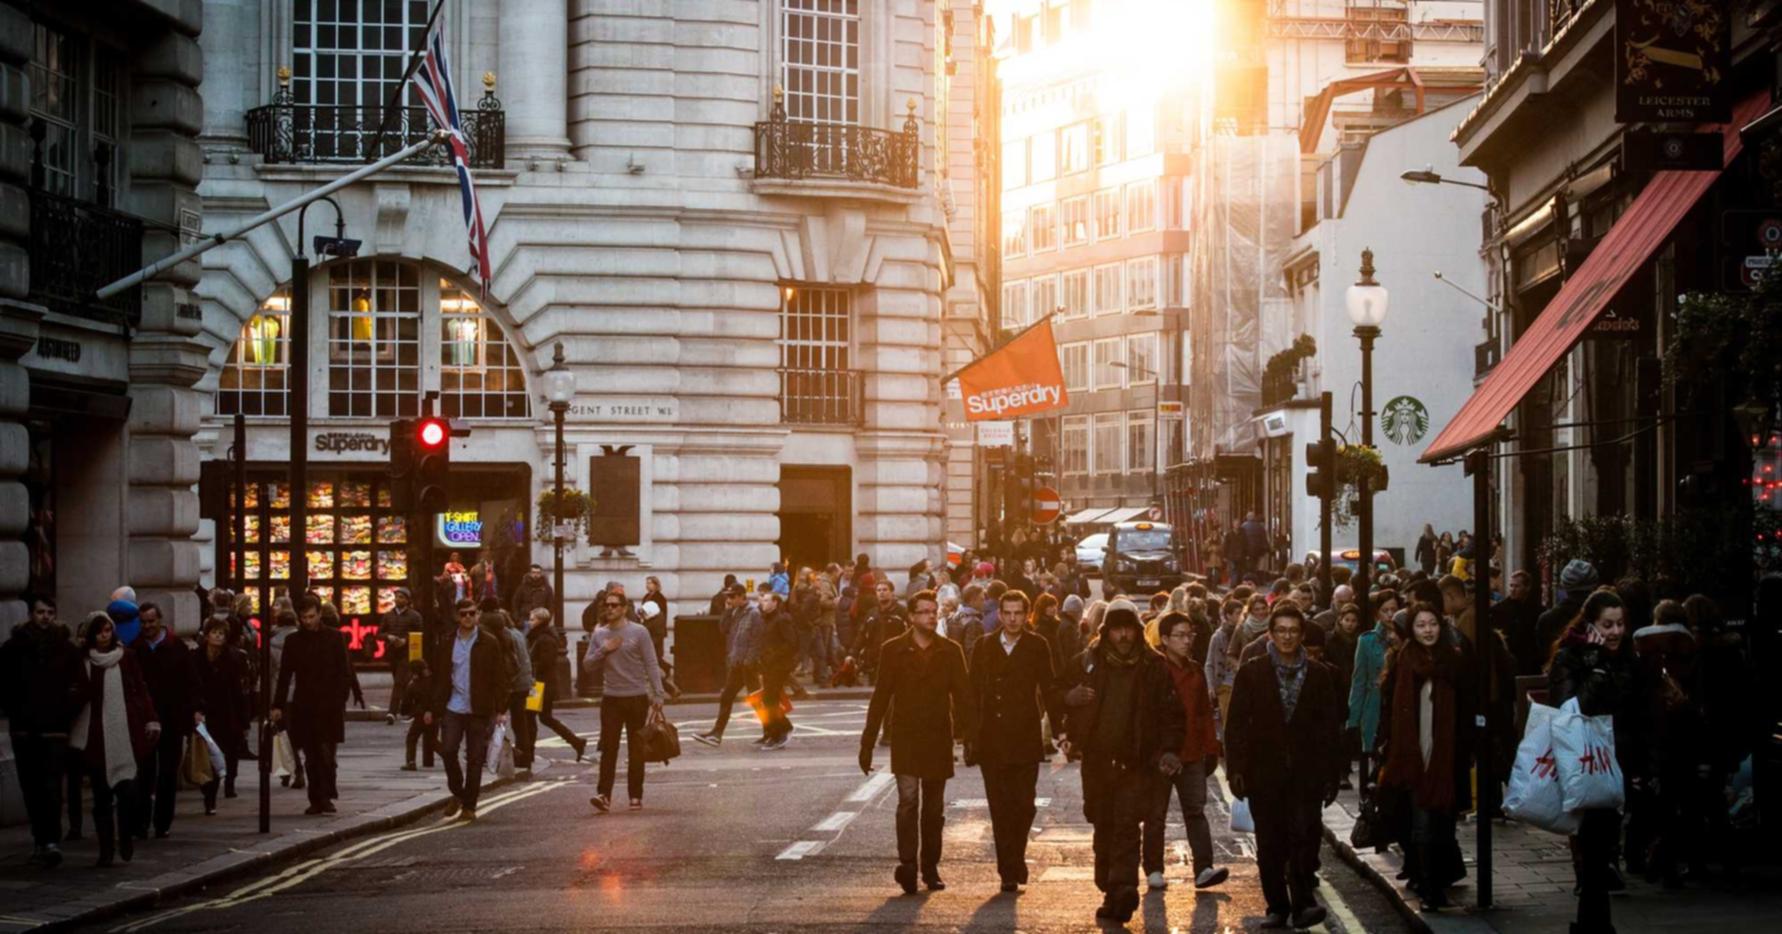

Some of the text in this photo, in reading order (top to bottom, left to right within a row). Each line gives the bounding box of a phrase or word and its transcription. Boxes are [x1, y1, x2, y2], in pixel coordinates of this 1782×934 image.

[1656, 107, 1695, 119] ARMS
[967, 384, 1060, 415] Superdry
[567, 405, 602, 416] GENT
[610, 405, 650, 416] STREET
[314, 432, 390, 455] Superdry
